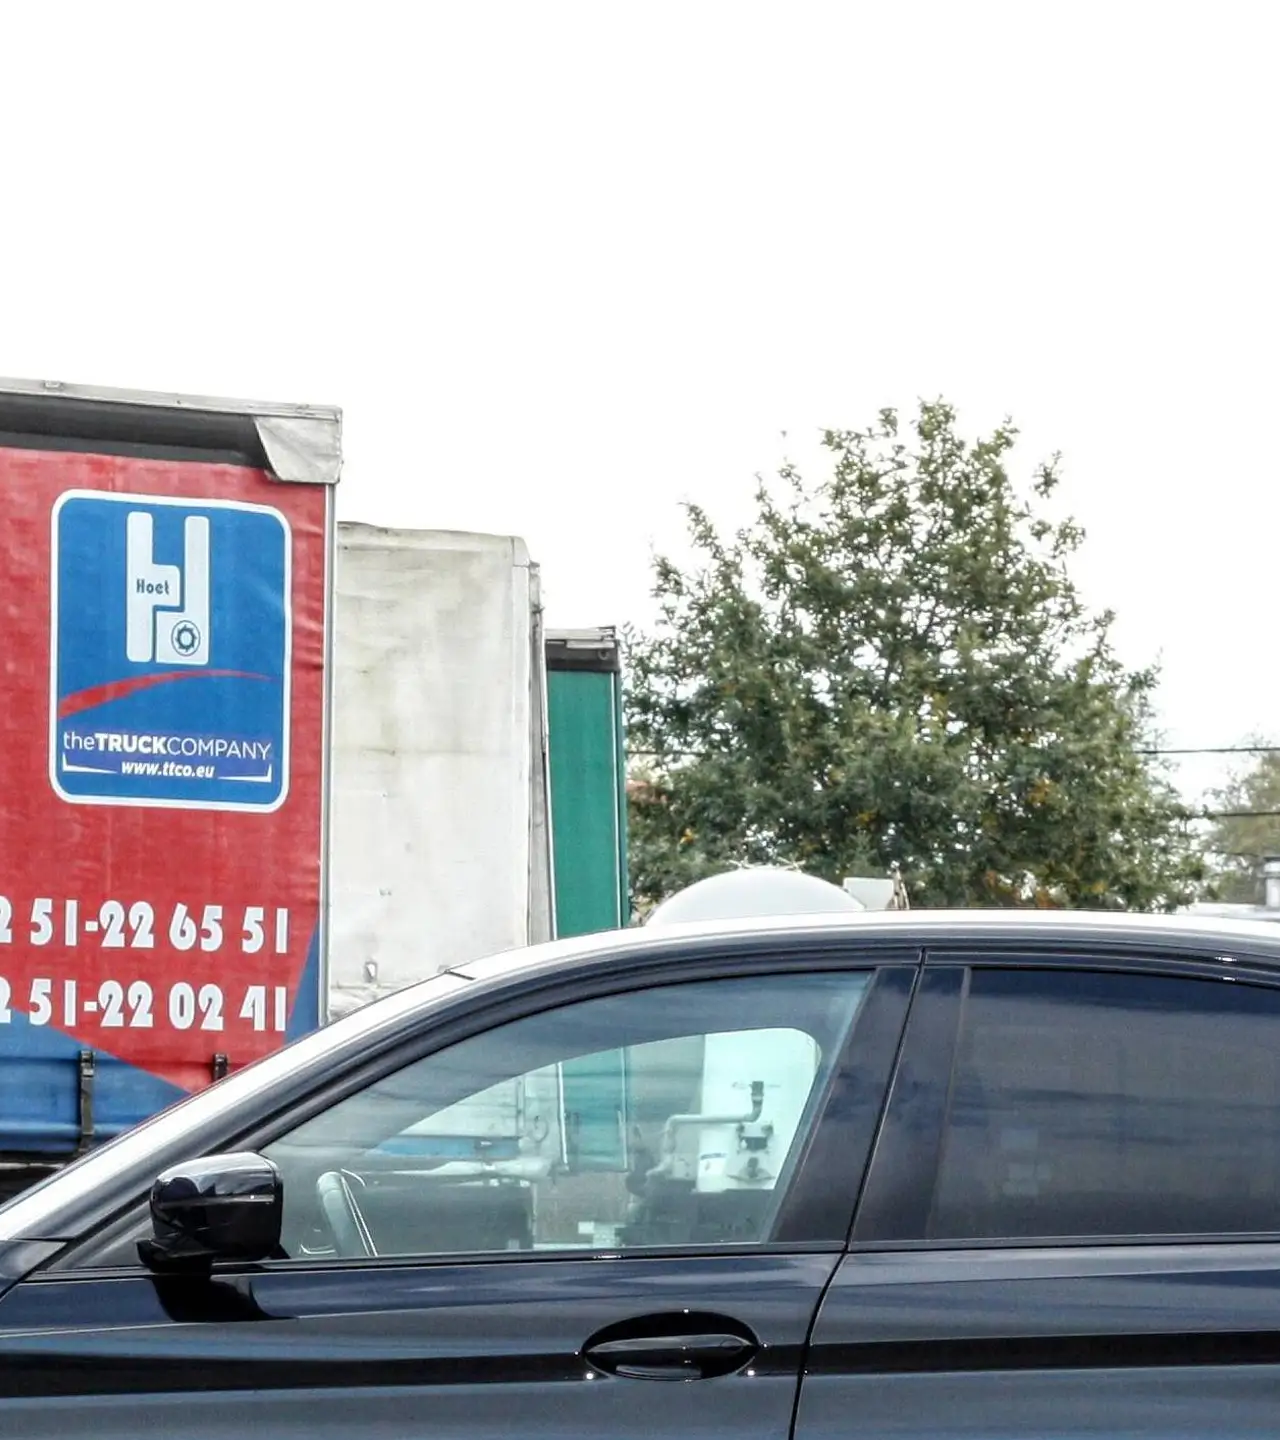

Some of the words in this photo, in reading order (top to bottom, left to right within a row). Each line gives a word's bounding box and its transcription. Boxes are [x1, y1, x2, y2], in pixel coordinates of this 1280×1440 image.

[136, 578, 170, 596] Hoet
[63, 731, 272, 761] theTRUCKCOMPANY
[121, 758, 215, 779] www.ttco.eu
[30, 898, 156, 949] 51-22
[168, 903, 223, 952] 65
[241, 907, 288, 954] 51
[28, 978, 154, 1028] 51-22
[168, 982, 224, 1032] 02
[239, 985, 287, 1032] 41
